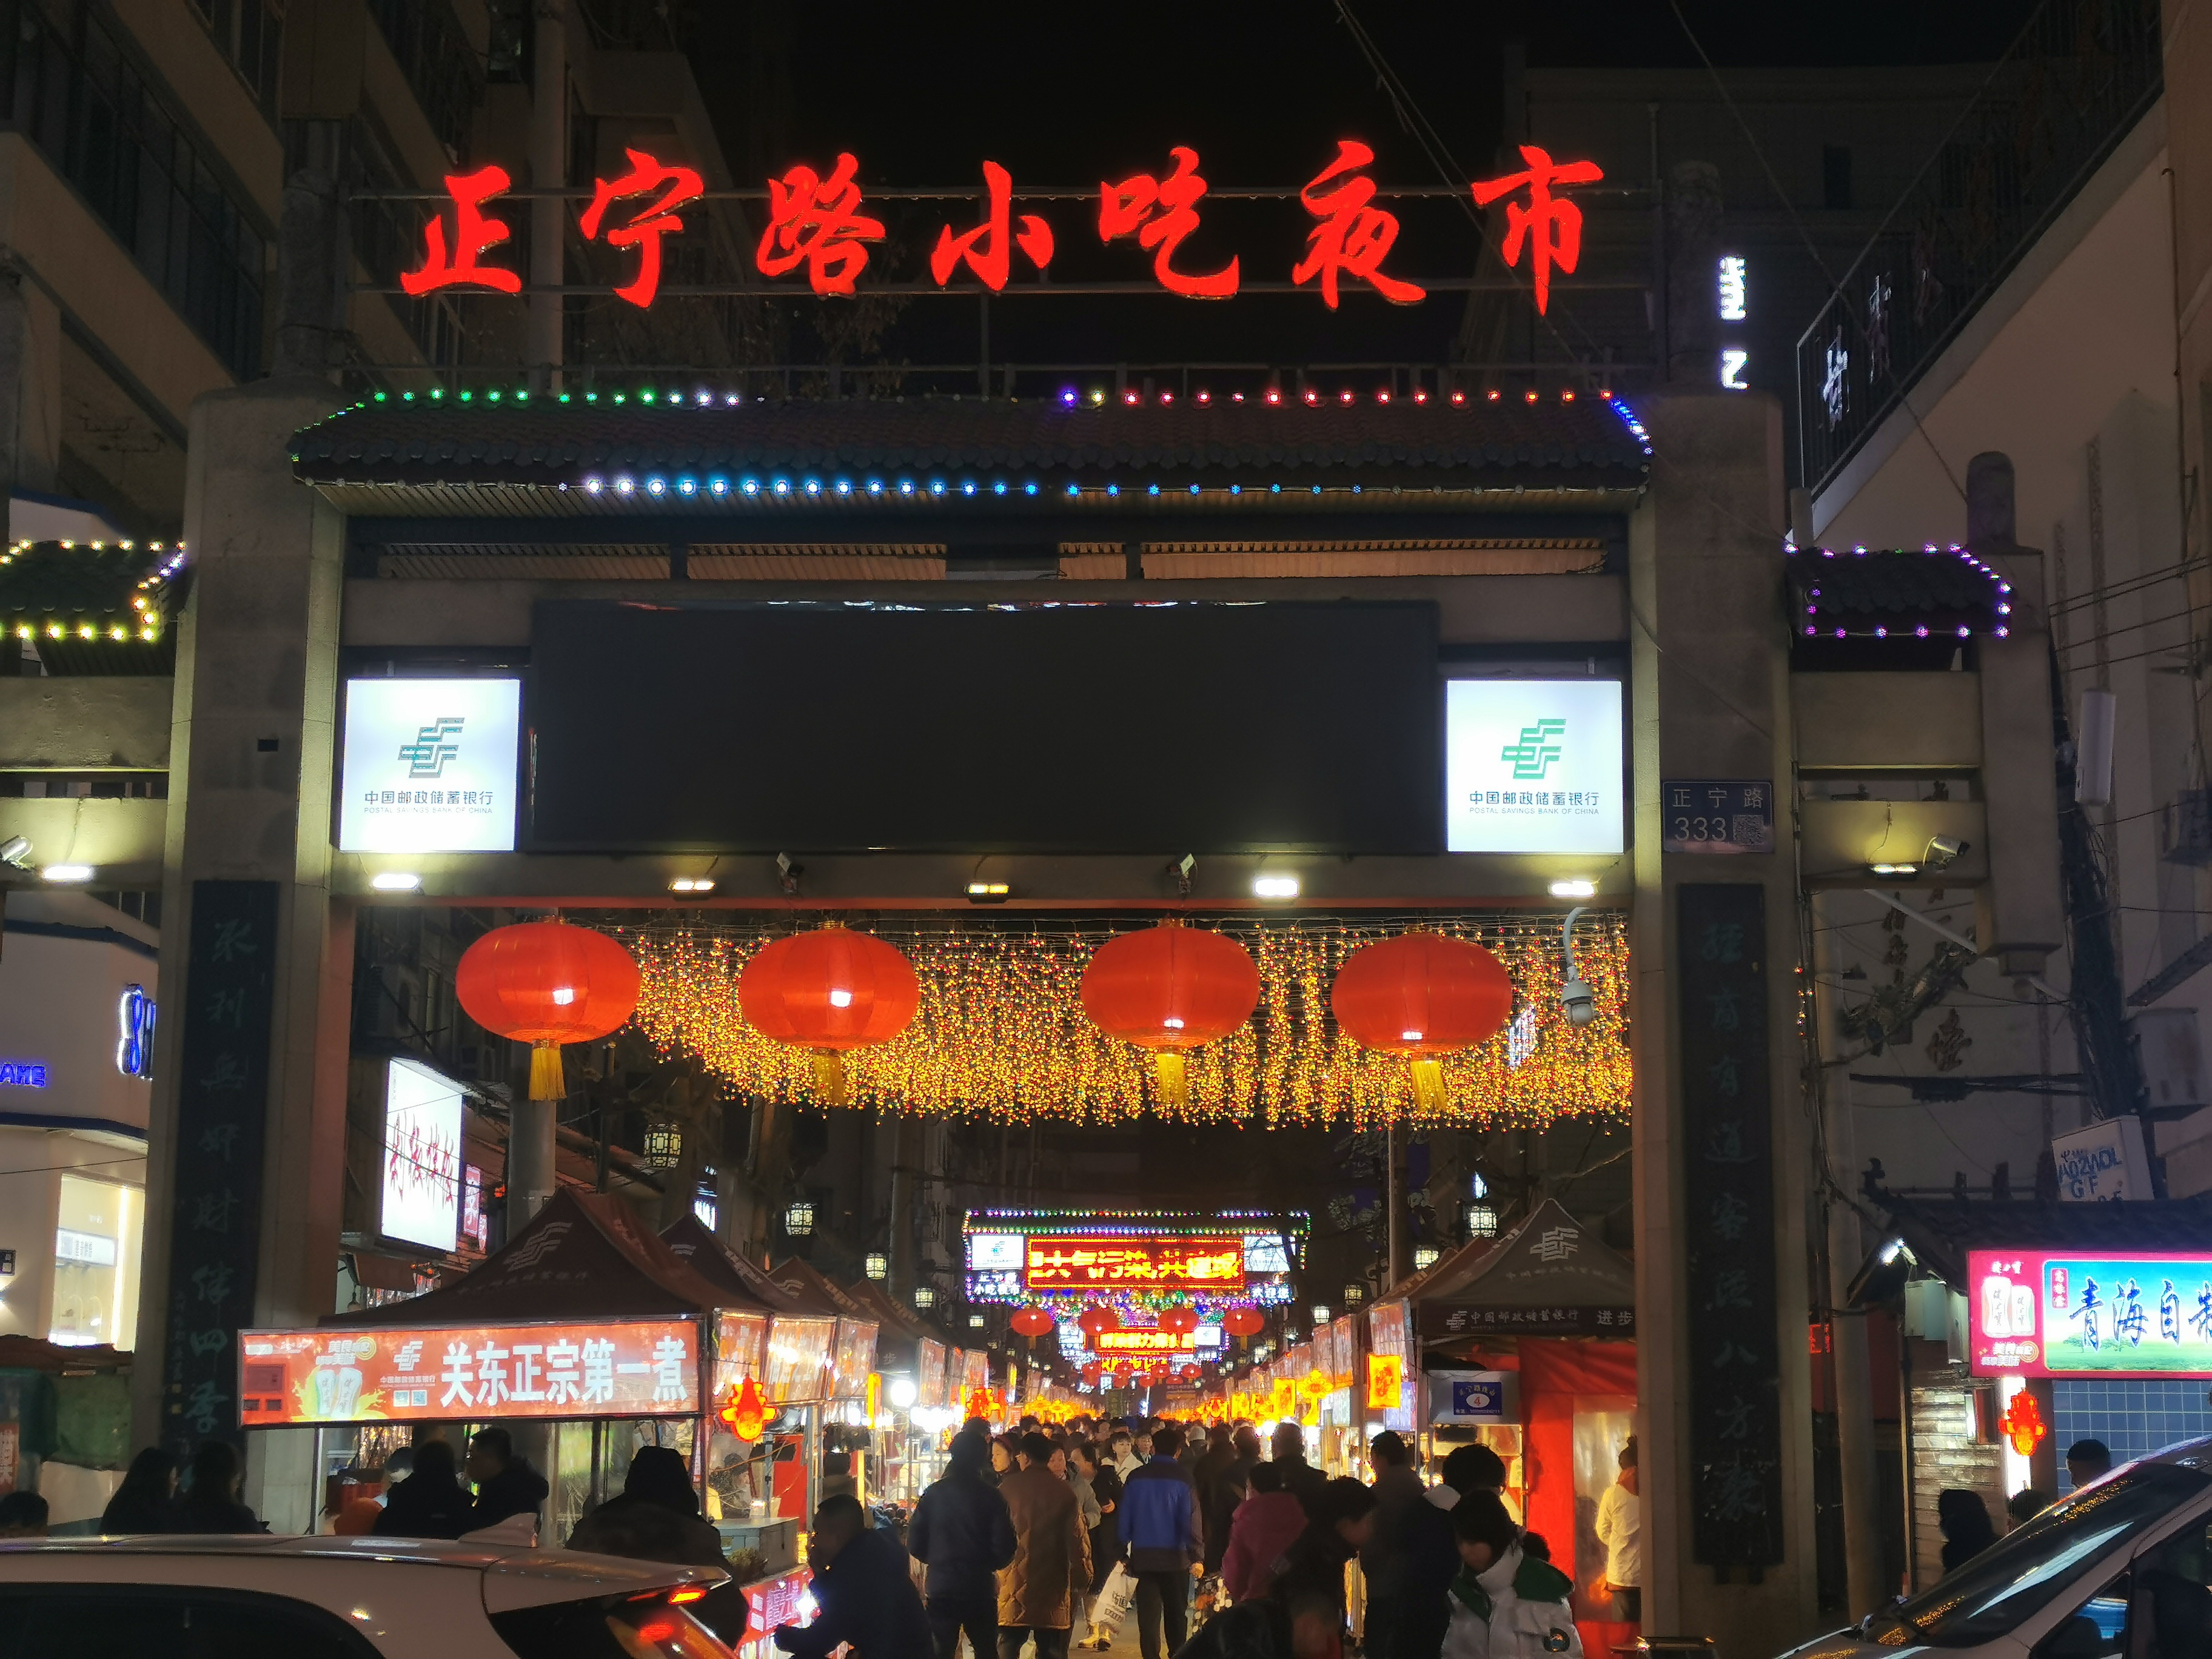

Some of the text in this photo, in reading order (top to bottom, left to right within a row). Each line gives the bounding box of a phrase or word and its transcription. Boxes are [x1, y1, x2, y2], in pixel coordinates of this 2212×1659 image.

[400, 140, 1604, 316] 正宁路小吃夜市
[364, 790, 493, 805] 中国邮政储蓄银行
[1470, 791, 1600, 806] 中国邮政储蓄银行
[1672, 787, 1763, 808] 正宁路
[1675, 817, 1727, 841] 333
[974, 1283, 1021, 1296] 小吃夜市
[441, 1336, 688, 1409] 关东正宗第一煮
[1474, 1396, 1481, 1406] 4
